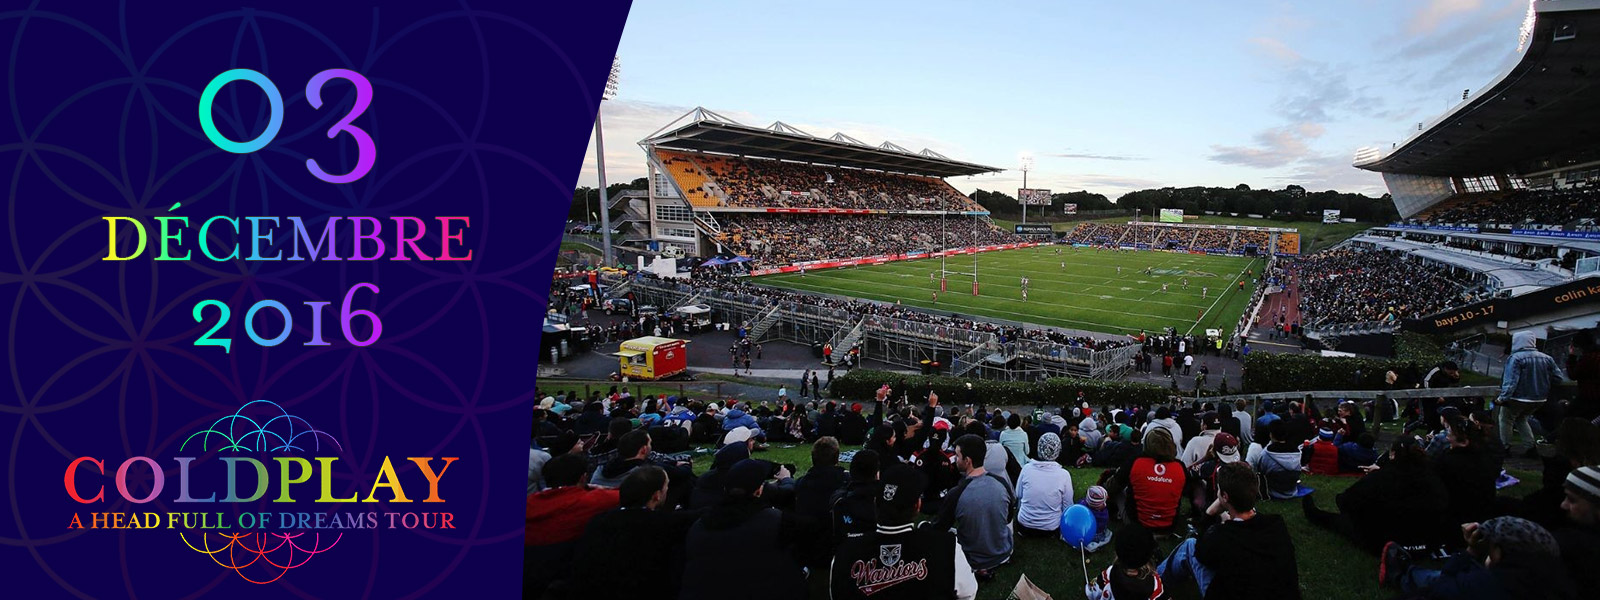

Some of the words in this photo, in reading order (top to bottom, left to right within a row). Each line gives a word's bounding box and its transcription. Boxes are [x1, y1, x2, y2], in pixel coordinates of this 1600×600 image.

[1554, 290, 1587, 304] colin
[1435, 316, 1459, 327] bays
[1146, 475, 1173, 484] vodafone
[850, 557, 928, 587] Warriors
